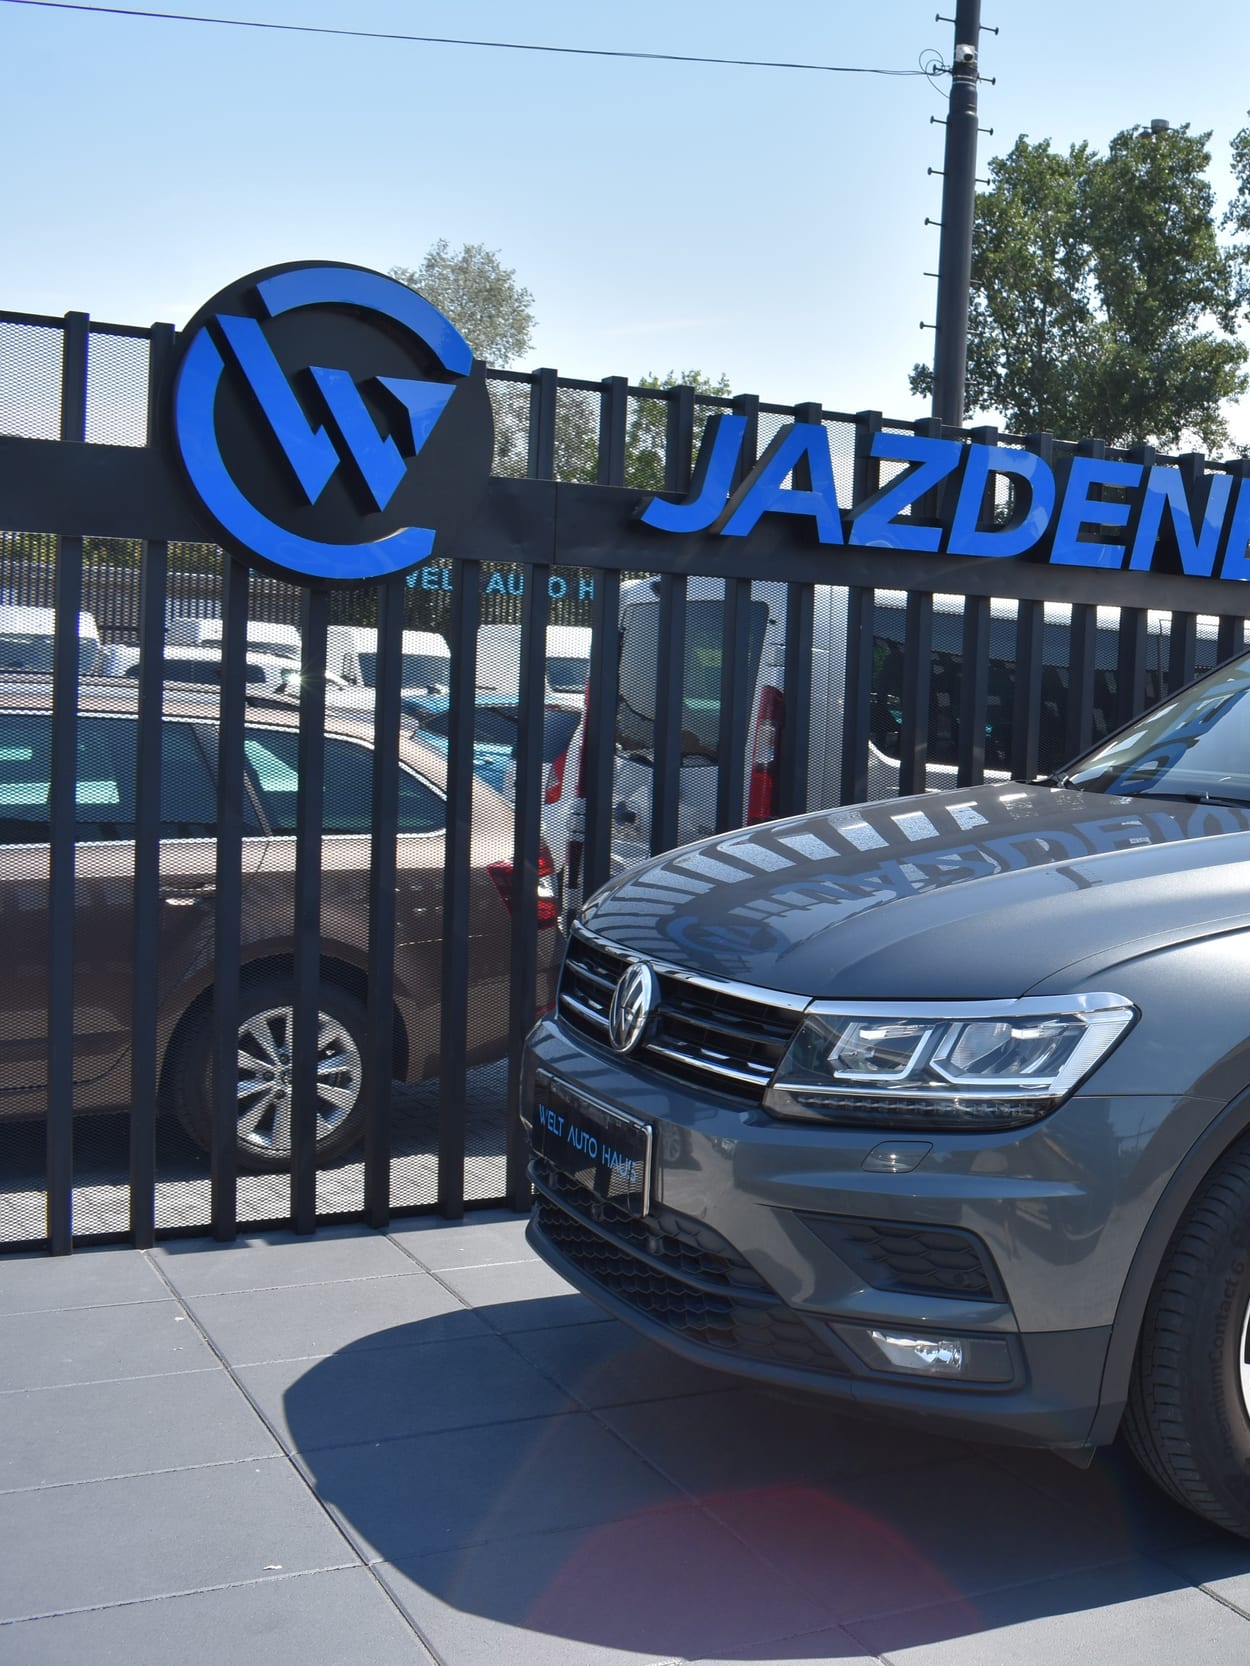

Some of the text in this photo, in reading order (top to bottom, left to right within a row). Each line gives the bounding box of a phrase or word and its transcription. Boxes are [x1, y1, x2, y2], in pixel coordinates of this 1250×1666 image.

[486, 572, 567, 599] AUO
[538, 1103, 565, 1137] WELT
[567, 1123, 598, 1159] AUTO
